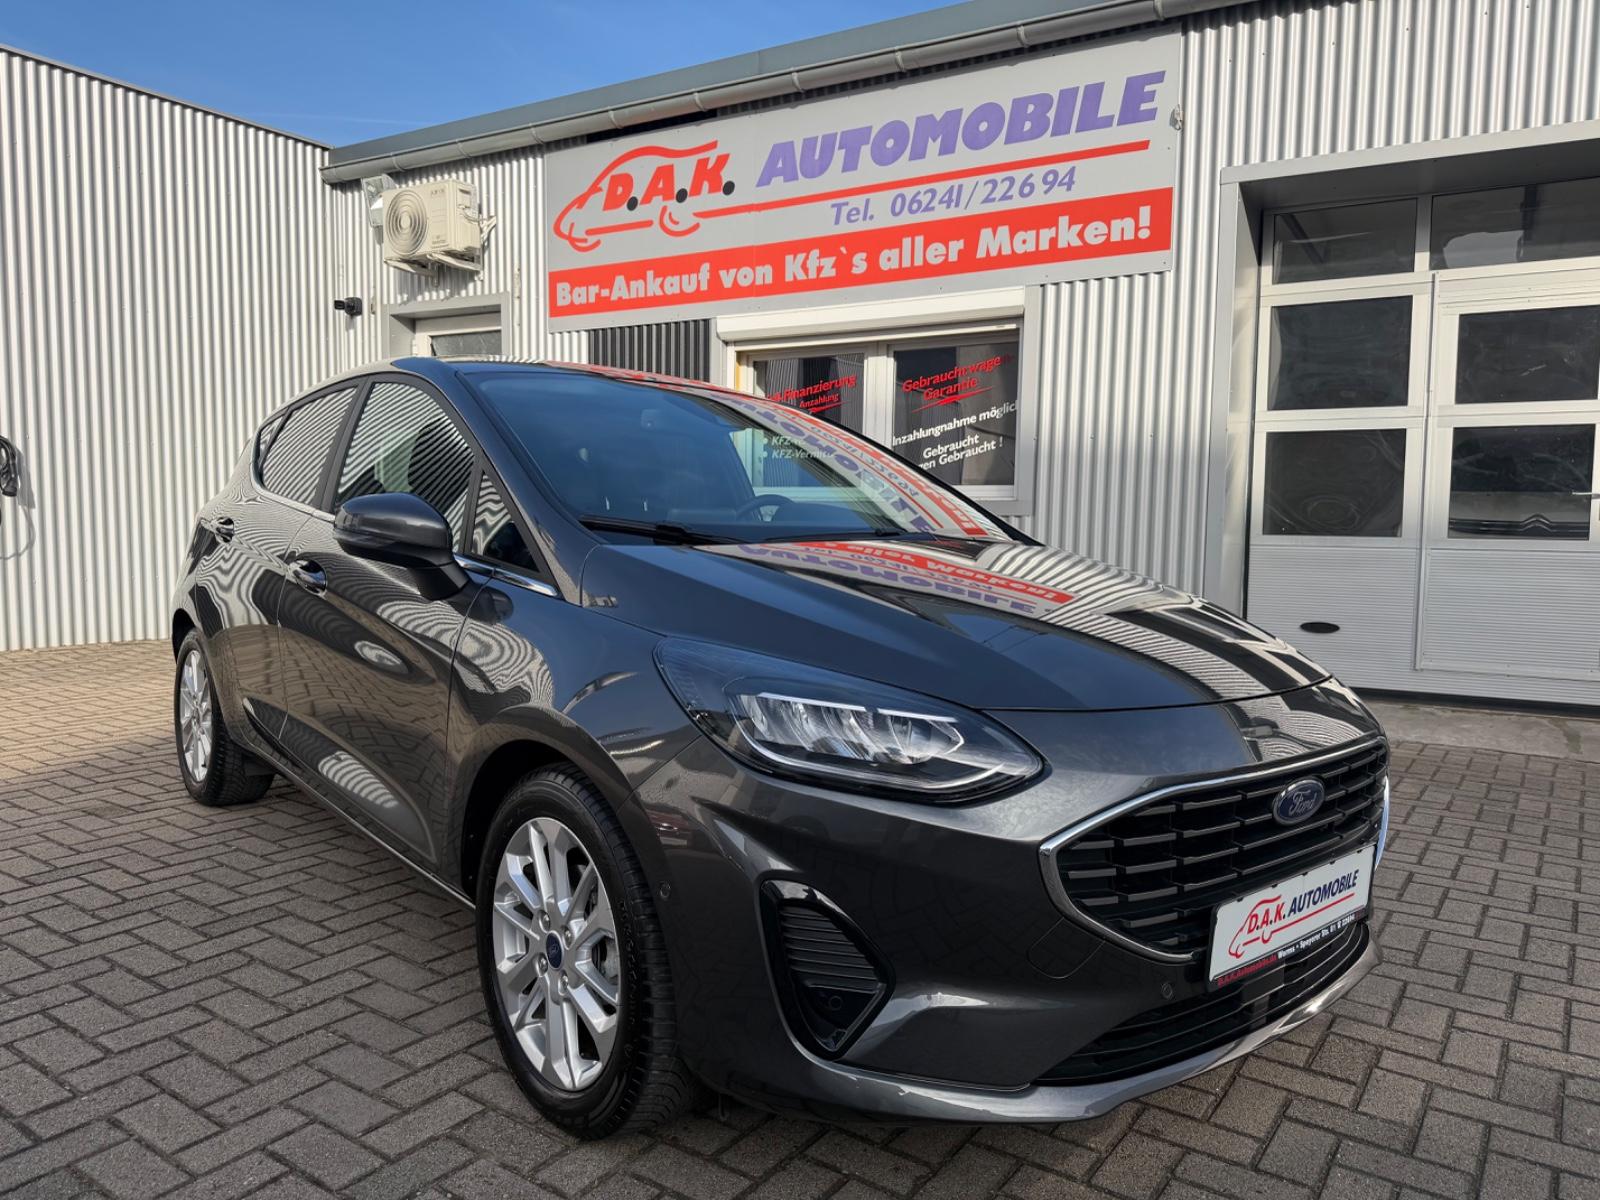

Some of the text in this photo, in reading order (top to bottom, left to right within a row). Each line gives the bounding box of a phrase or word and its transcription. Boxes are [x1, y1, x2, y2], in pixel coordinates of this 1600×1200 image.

[603, 72, 1165, 212] D.A.K. AUTOMOBILE
[831, 198, 875, 225] Tel.
[556, 263, 710, 307] Bar-Ankauf
[719, 263, 773, 289] von
[879, 237, 965, 270] aller
[976, 206, 1152, 258] Marken!
[923, 376, 978, 401] Garantie
[923, 434, 979, 459] Gebraucht
[939, 440, 996, 465] Gebraucht
[1288, 789, 1318, 817] Ford
[1247, 902, 1286, 935] D.A.K.
[1287, 869, 1360, 917] AUTOMOBILE
